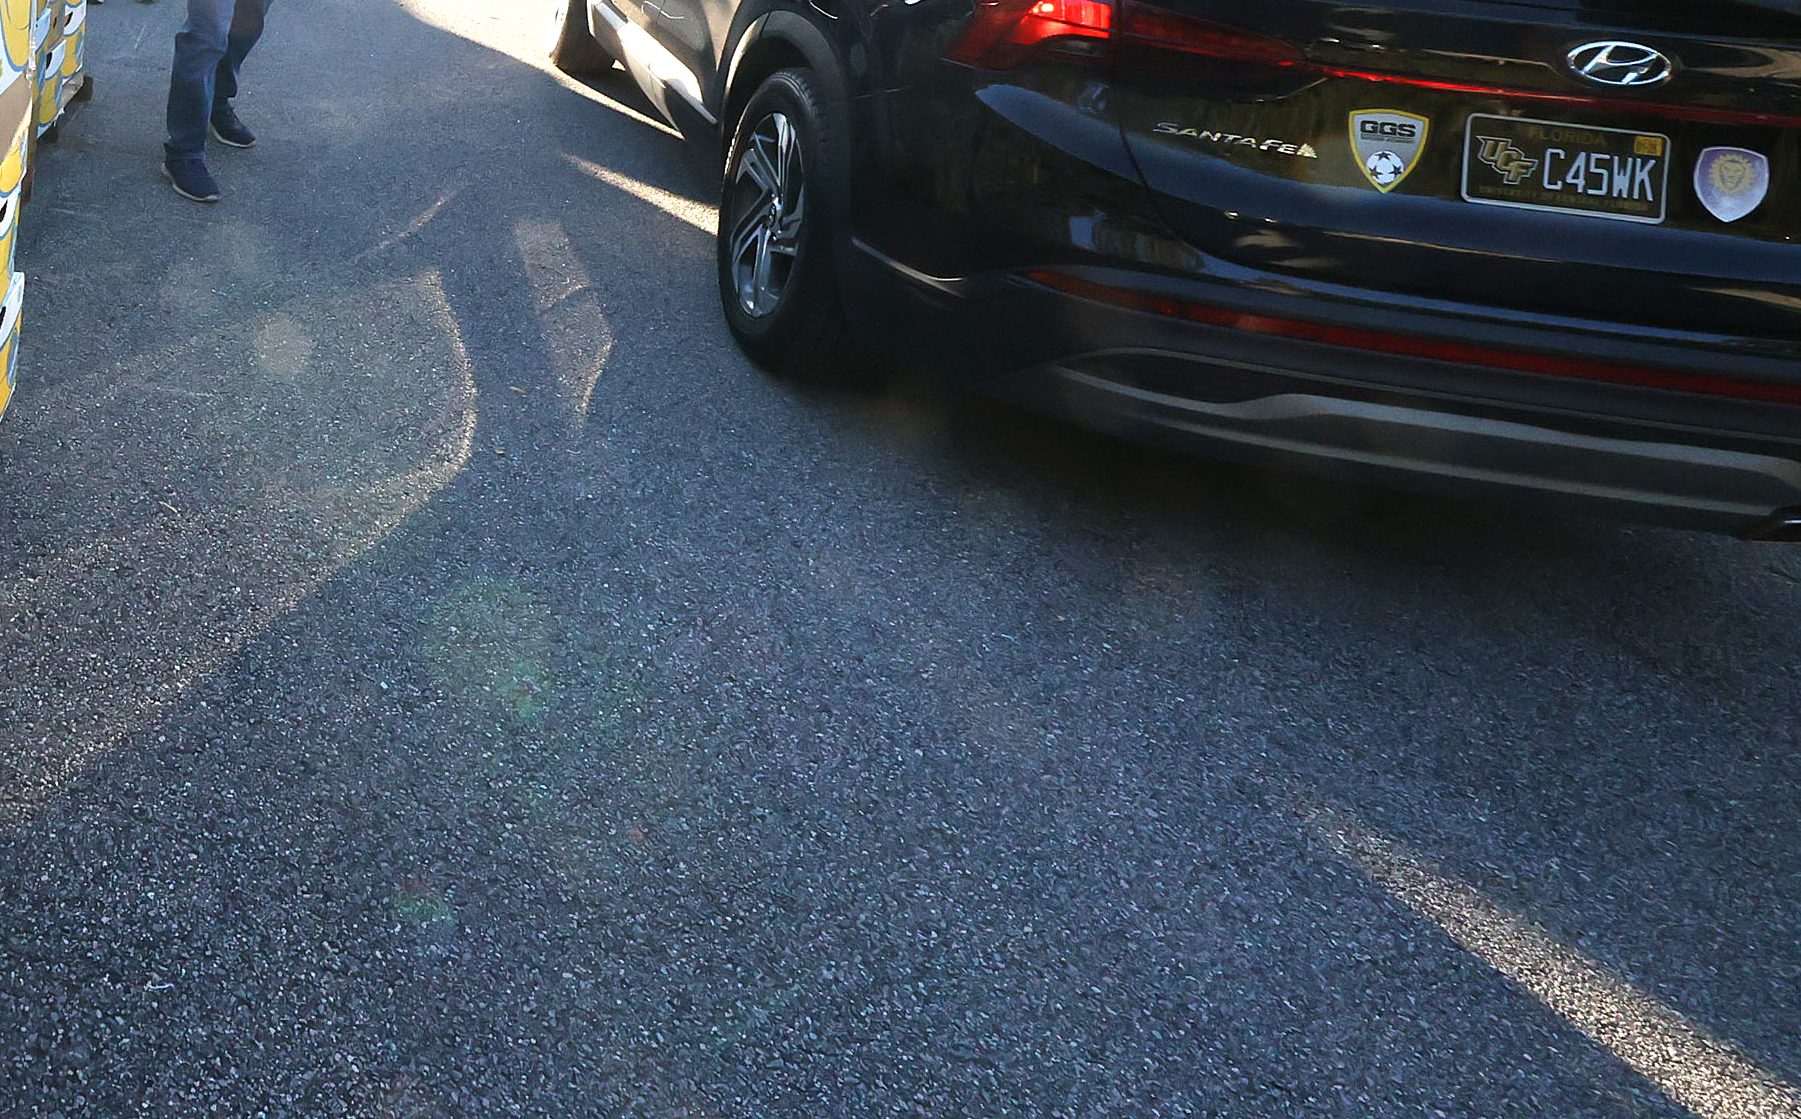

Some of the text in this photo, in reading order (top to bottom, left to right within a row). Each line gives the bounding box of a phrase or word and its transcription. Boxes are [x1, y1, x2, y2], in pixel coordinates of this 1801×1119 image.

[1152, 121, 1299, 155] SANTA FE
[1360, 120, 1416, 138] GGS
[1527, 125, 1606, 145] FLORIDA
[1482, 138, 1535, 182] UCF
[1543, 147, 1657, 202] C45WK
